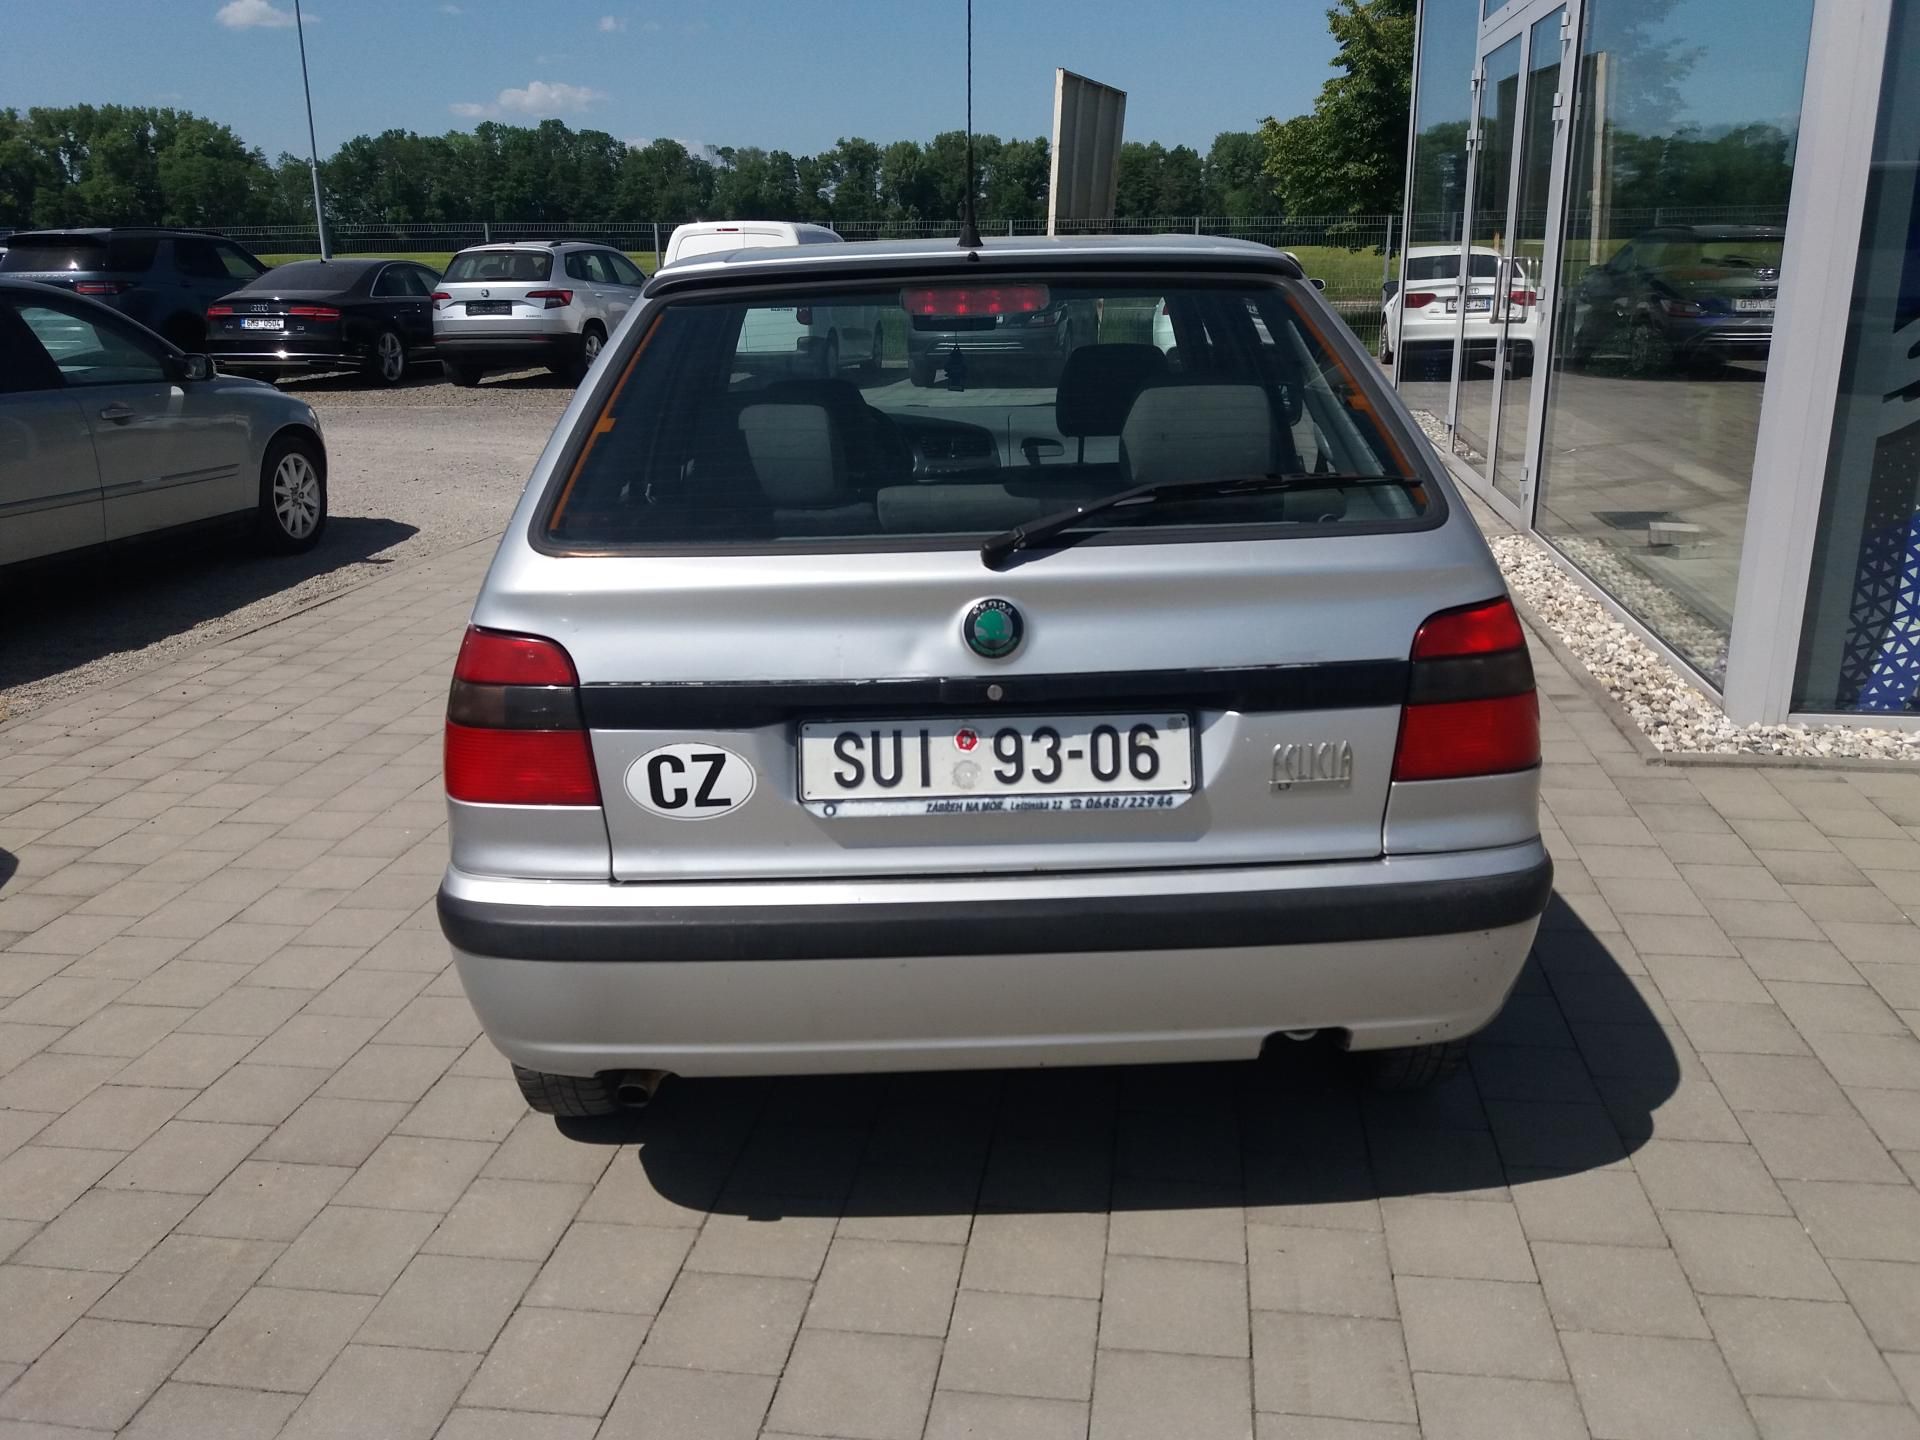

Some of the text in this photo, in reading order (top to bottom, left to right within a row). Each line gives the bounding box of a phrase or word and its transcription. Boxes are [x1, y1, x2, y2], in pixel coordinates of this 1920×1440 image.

[647, 753, 732, 809] CZ
[833, 724, 1160, 788] SUI 93-06
[965, 801, 979, 812] NA
